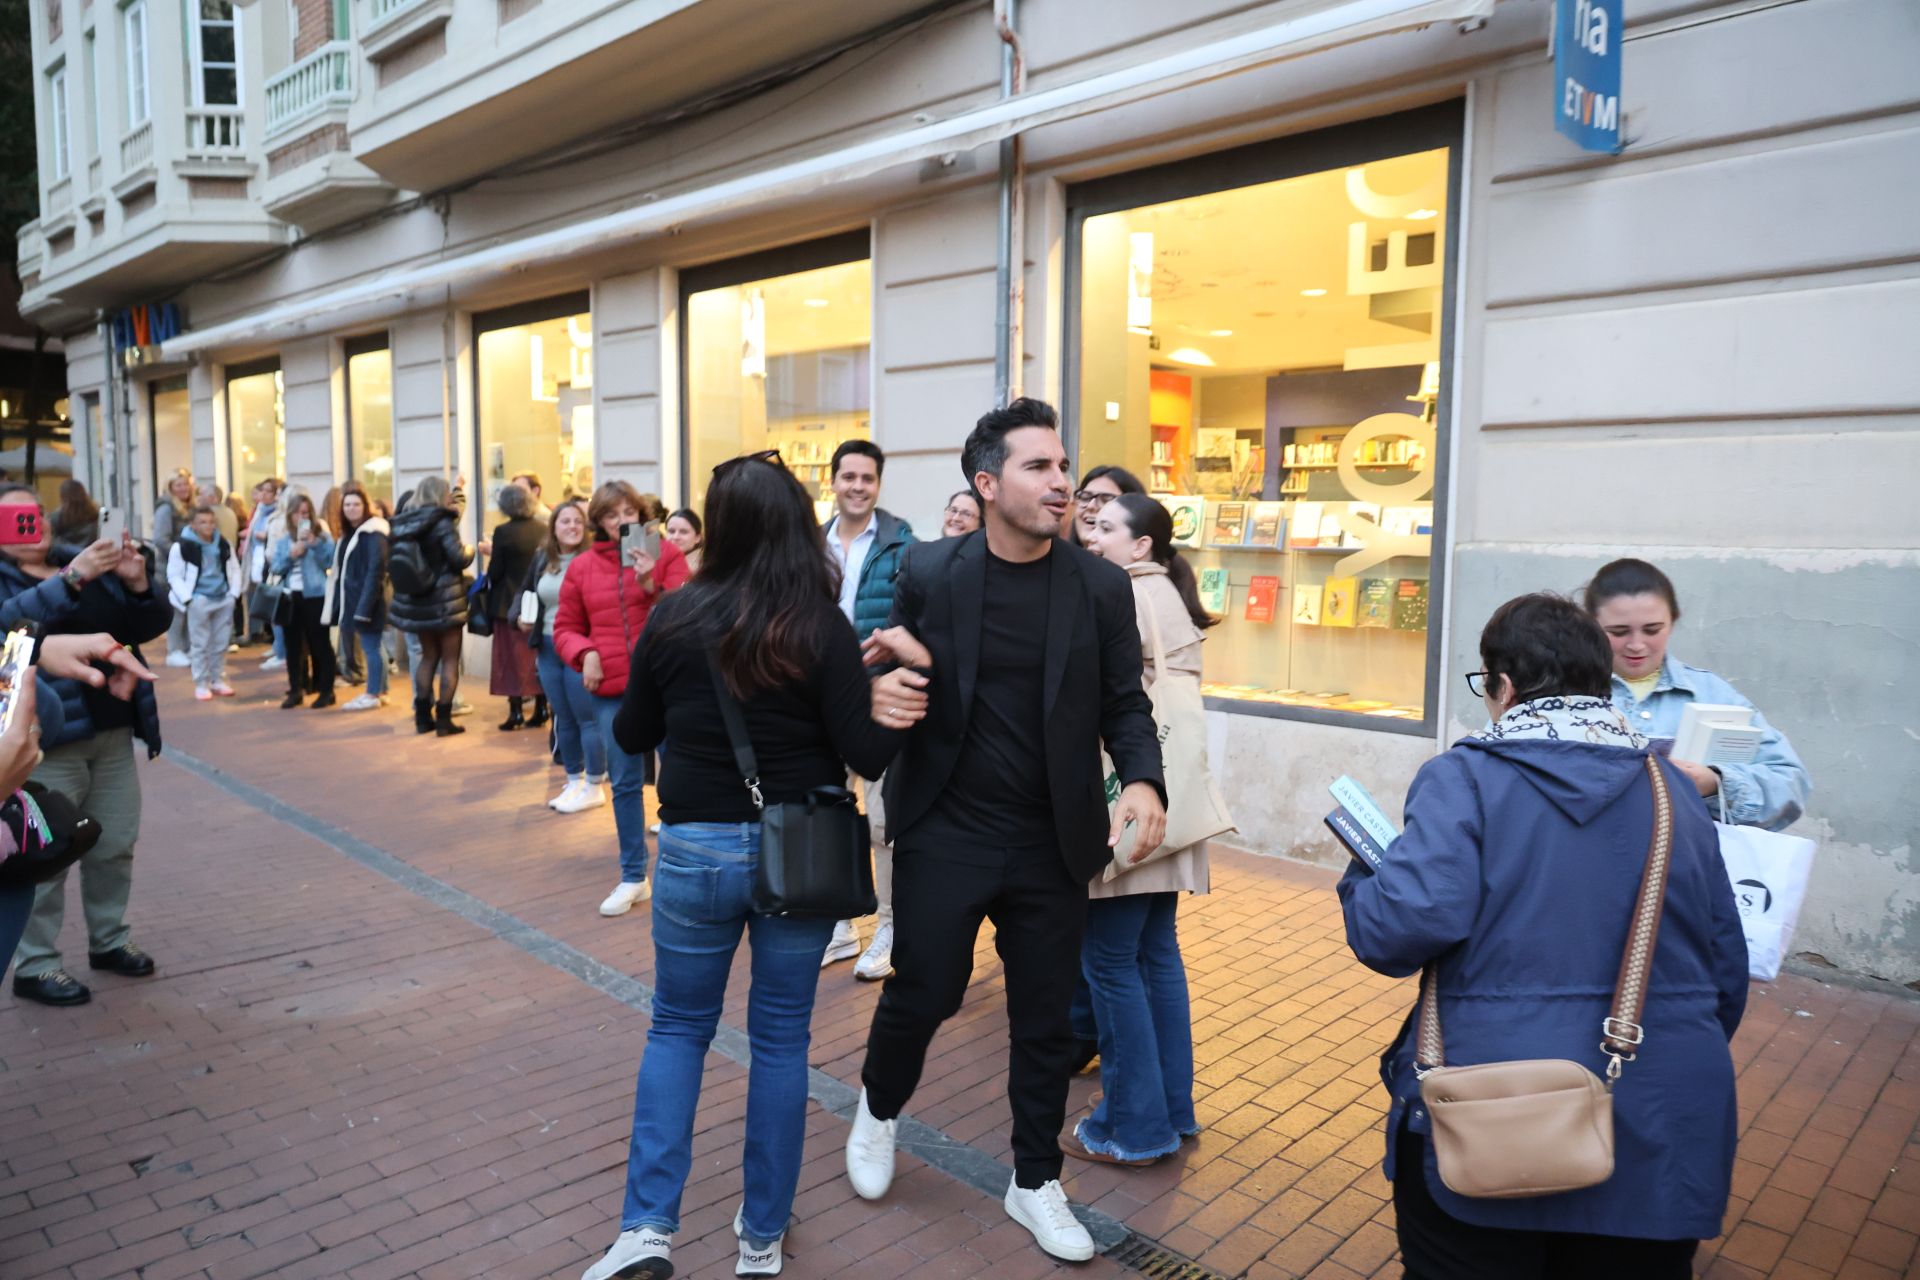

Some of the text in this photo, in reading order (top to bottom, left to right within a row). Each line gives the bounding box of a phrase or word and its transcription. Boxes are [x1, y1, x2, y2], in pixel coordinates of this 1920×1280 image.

[1564, 77, 1617, 131] ETVM
[1338, 784, 1364, 813] JAVIER
[1335, 815, 1362, 844] JAVIER
[743, 1252, 774, 1262] HOFF
